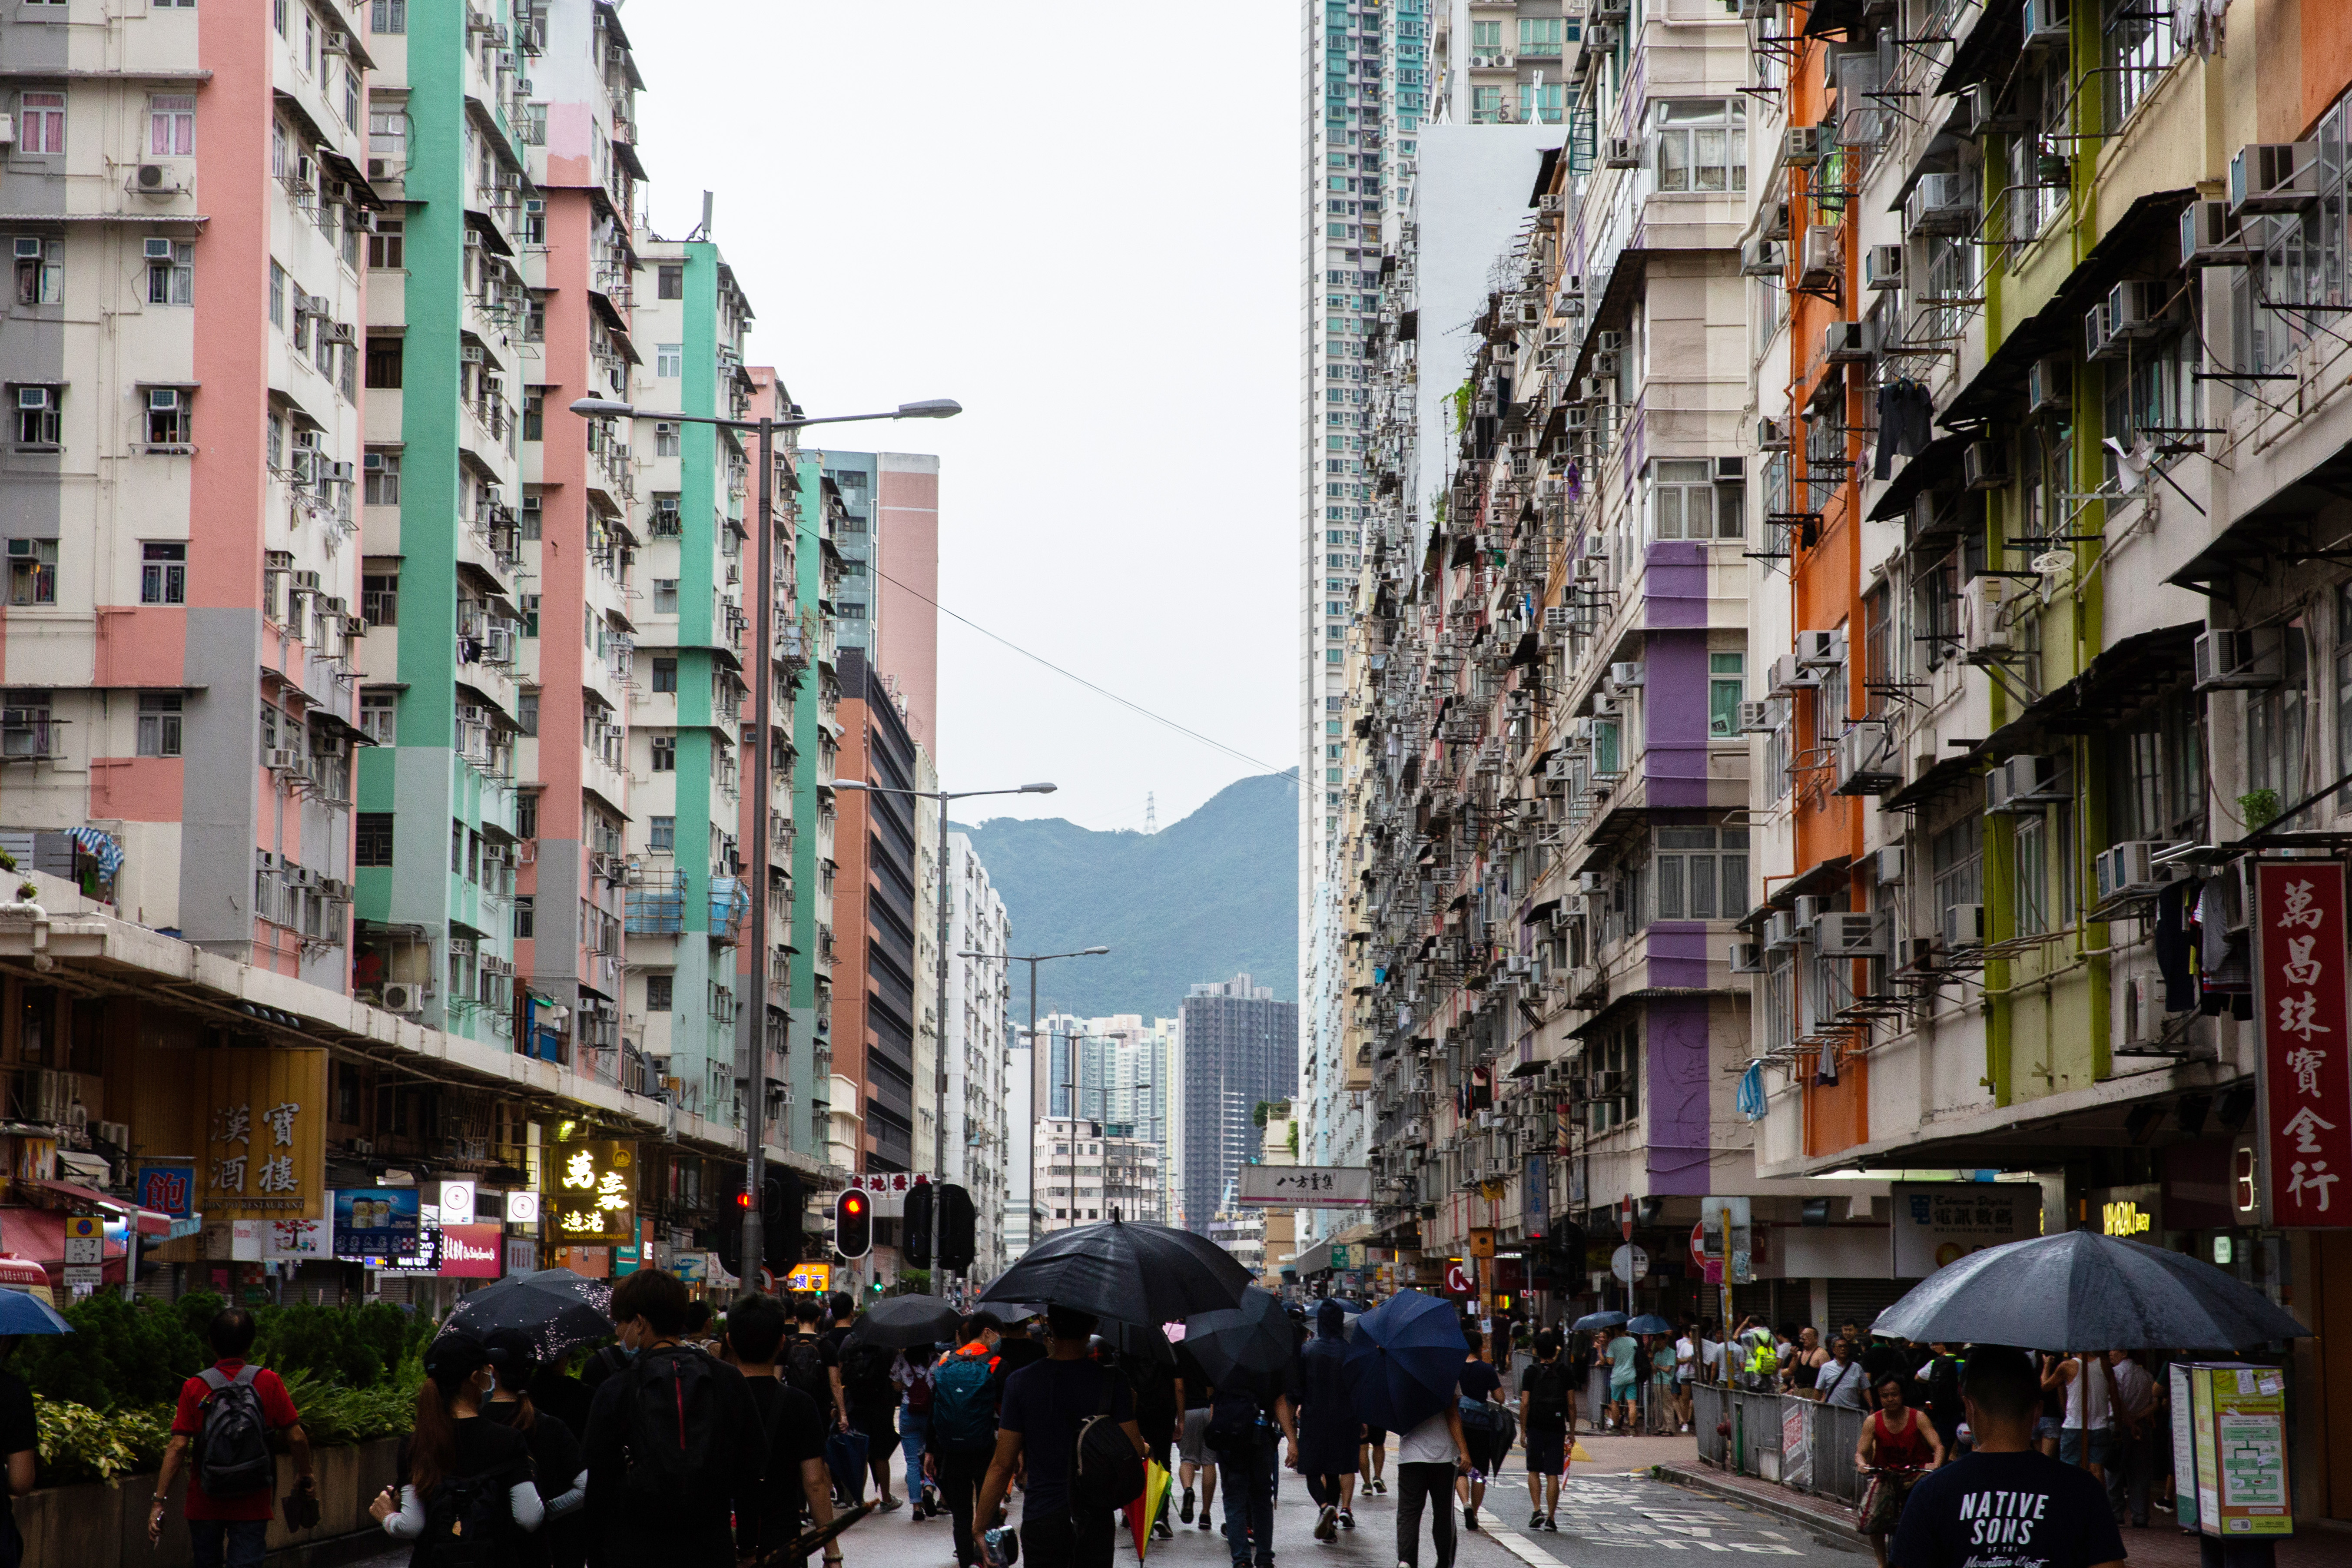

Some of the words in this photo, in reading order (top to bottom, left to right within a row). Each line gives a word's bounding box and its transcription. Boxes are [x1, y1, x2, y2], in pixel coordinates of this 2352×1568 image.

[2277, 879, 2339, 1212] 萬昌珠寶金行
[1934, 1208, 2013, 1225] 電訊數碼
[1959, 1491, 2049, 1521] NATIVE
[1970, 1518, 2034, 1545] SONS
[1582, 1536, 1807, 1556] BUS
